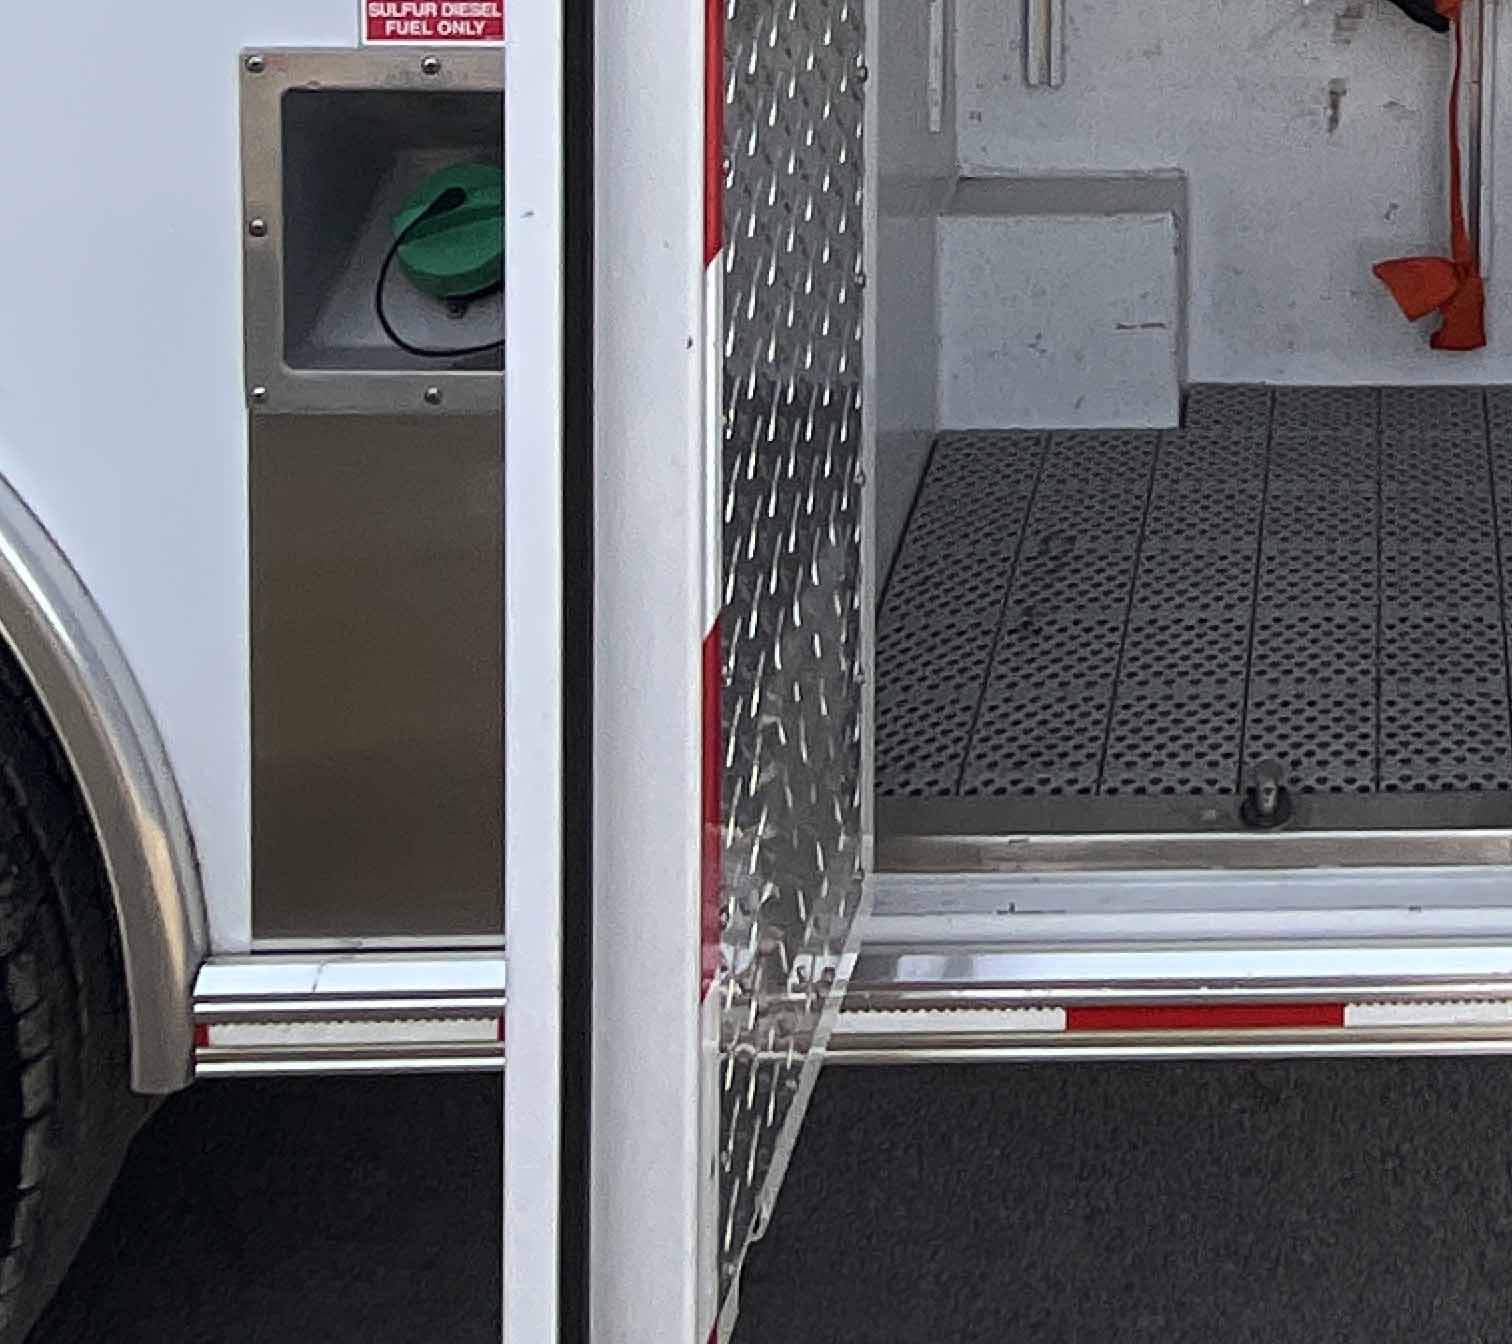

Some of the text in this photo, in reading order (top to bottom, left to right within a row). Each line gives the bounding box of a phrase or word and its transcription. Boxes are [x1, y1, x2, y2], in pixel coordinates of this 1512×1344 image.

[368, 2, 502, 18] SULFUR DIESEL
[386, 20, 486, 36] FUEL ONLY
